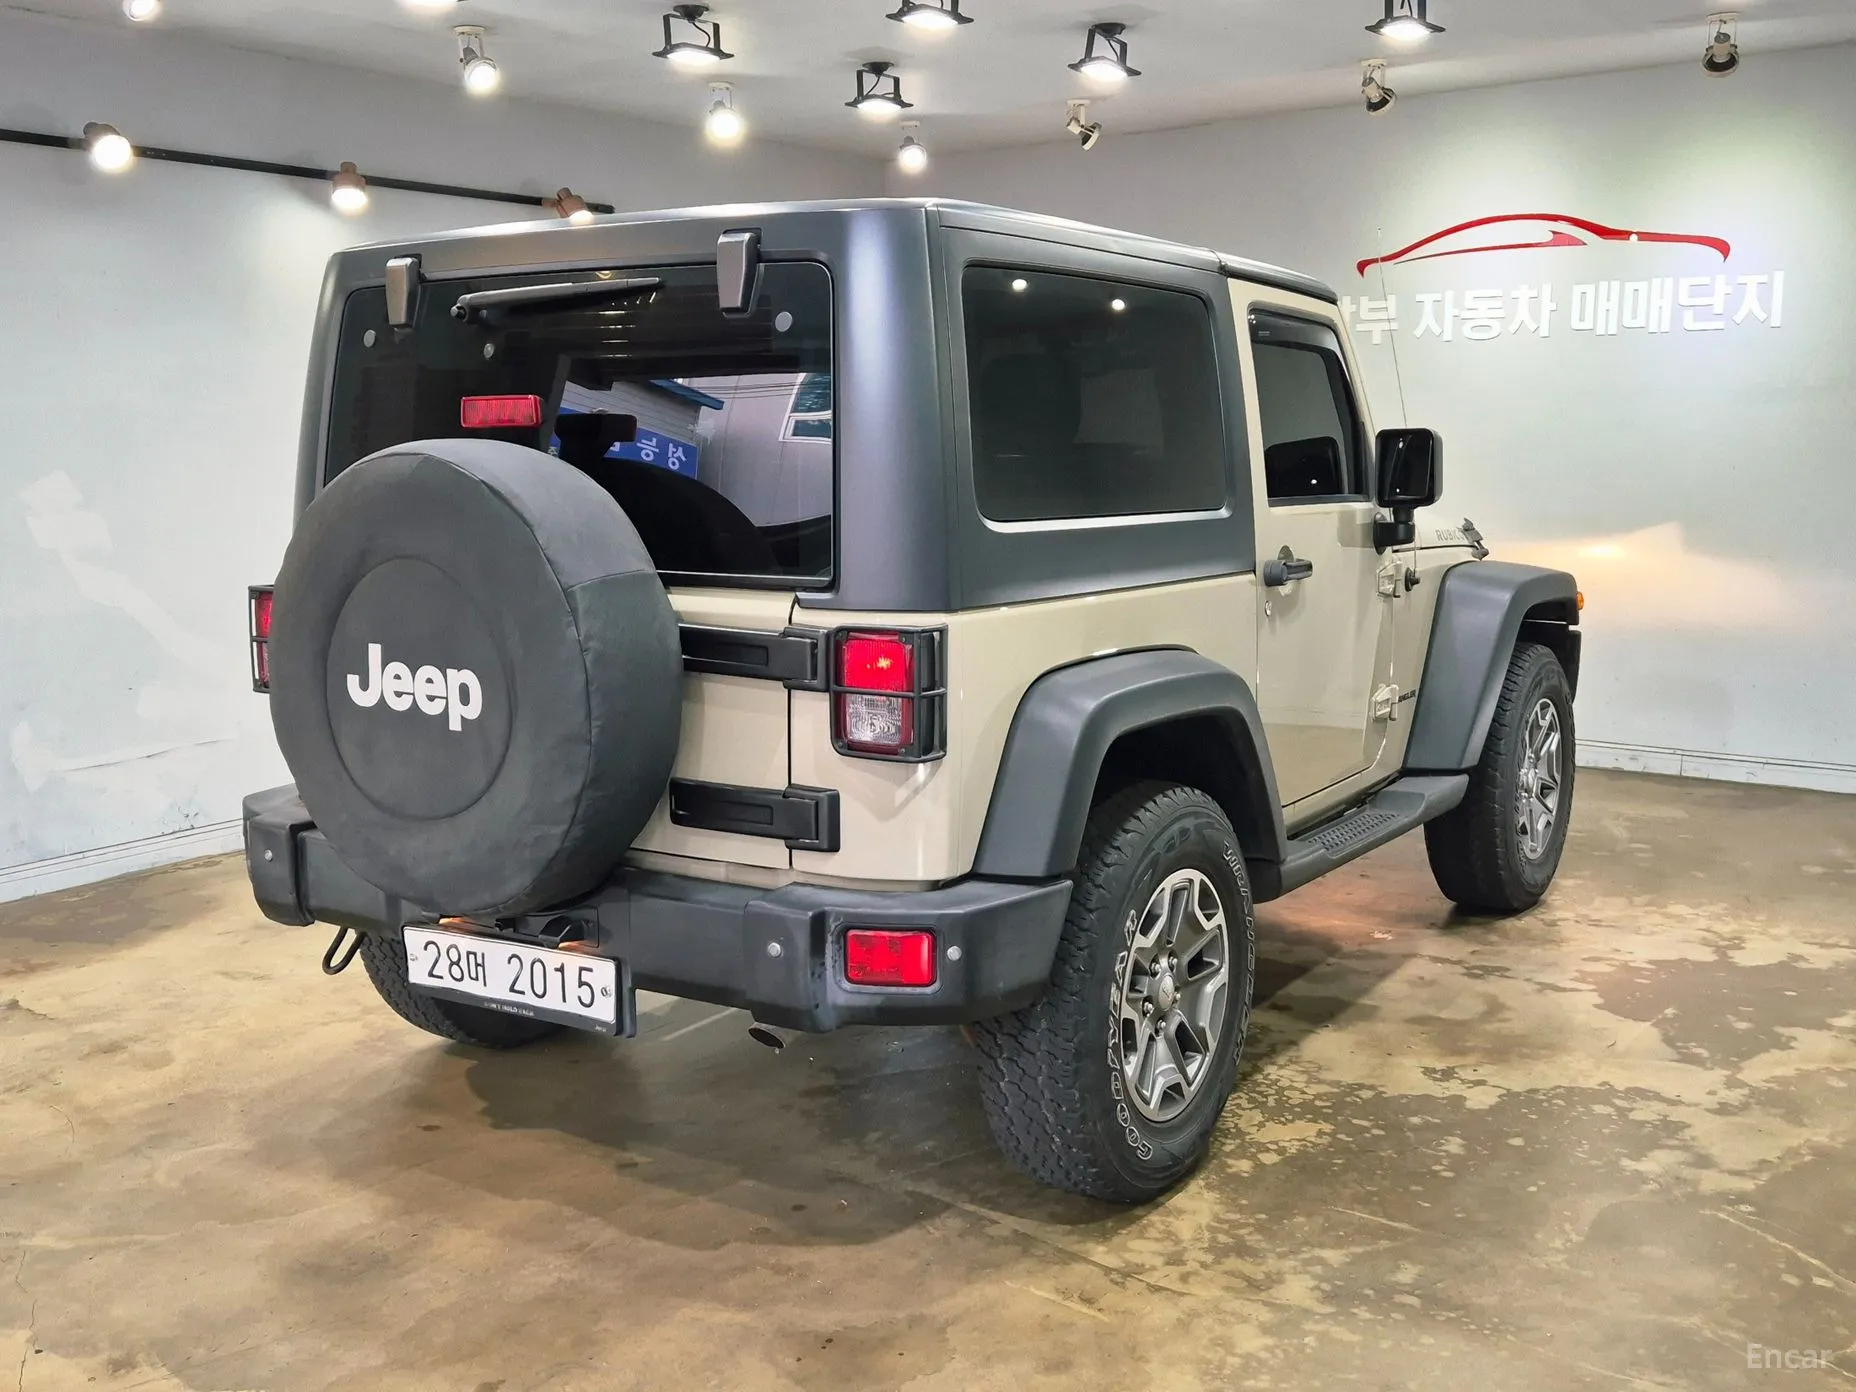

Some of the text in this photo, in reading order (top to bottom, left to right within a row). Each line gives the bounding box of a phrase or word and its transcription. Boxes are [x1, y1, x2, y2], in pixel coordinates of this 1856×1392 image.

[1413, 282, 1558, 342] 자동차
[1571, 269, 1786, 337] 매매단지
[346, 642, 483, 732] Jeep
[423, 940, 596, 1009] 28머 2015
[1106, 909, 1154, 1161] GOODYEAR
